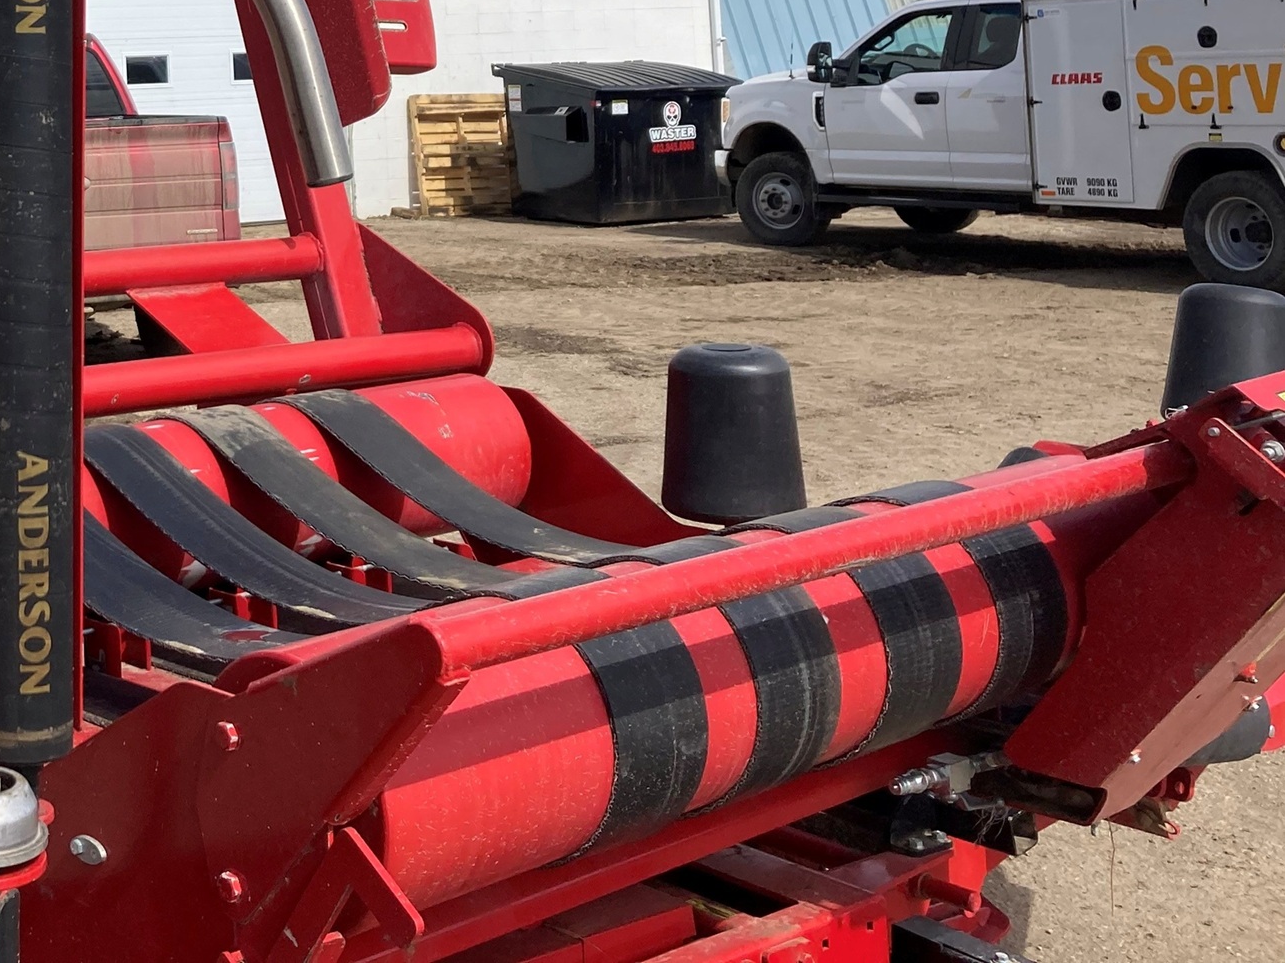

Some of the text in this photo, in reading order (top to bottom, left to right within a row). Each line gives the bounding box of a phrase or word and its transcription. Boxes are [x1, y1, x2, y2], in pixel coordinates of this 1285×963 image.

[1051, 72, 1103, 85] CLAAS
[1135, 45, 1282, 115] Serv
[651, 127, 694, 140] WASTER
[1056, 177, 1118, 187] GVWR 9090 KG
[1057, 187, 1075, 196] TARE
[1107, 188, 1118, 197] KG
[16, 450, 52, 695] ANDERSON
